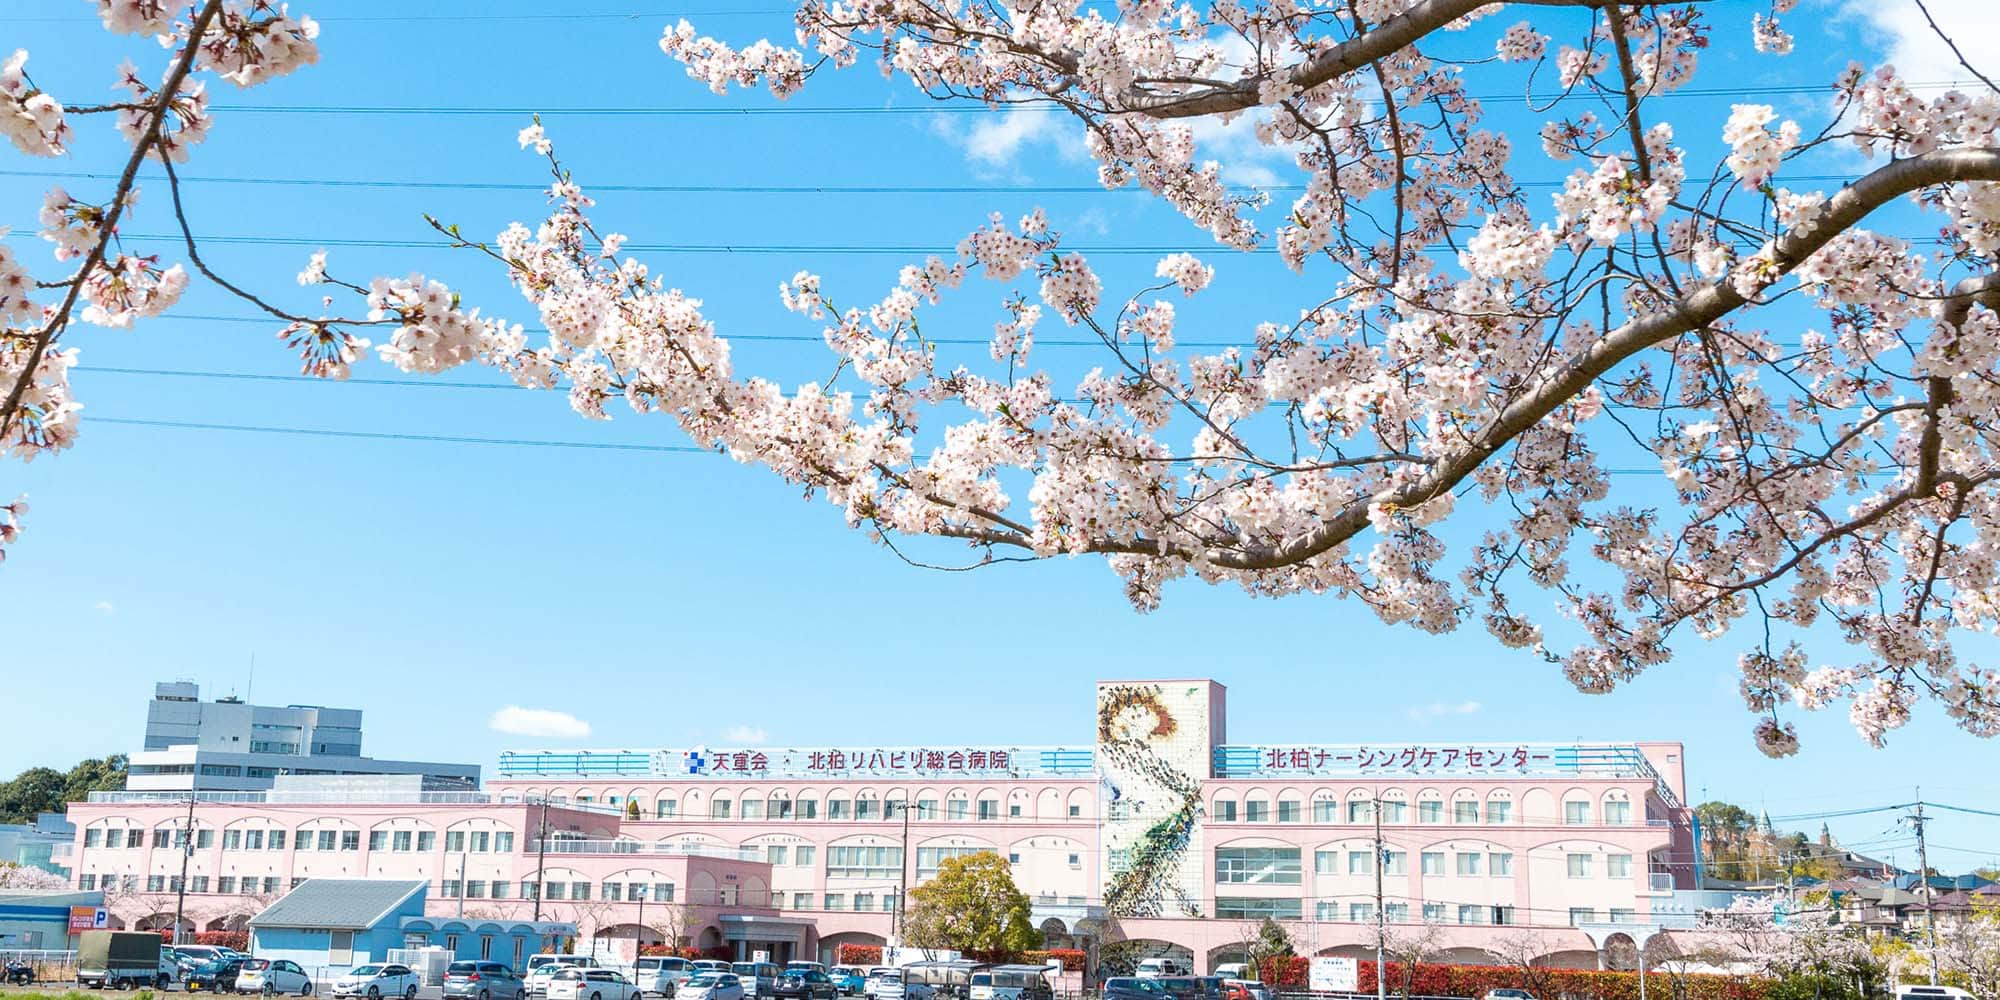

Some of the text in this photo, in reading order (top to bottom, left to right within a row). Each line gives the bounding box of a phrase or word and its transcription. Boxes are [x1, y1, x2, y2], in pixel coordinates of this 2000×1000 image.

[807, 751, 1008, 770] 北柏リハビリ総合病院
[1266, 747, 1550, 769] 北柏ナーシングケアセンター
[96, 911, 106, 924] P
